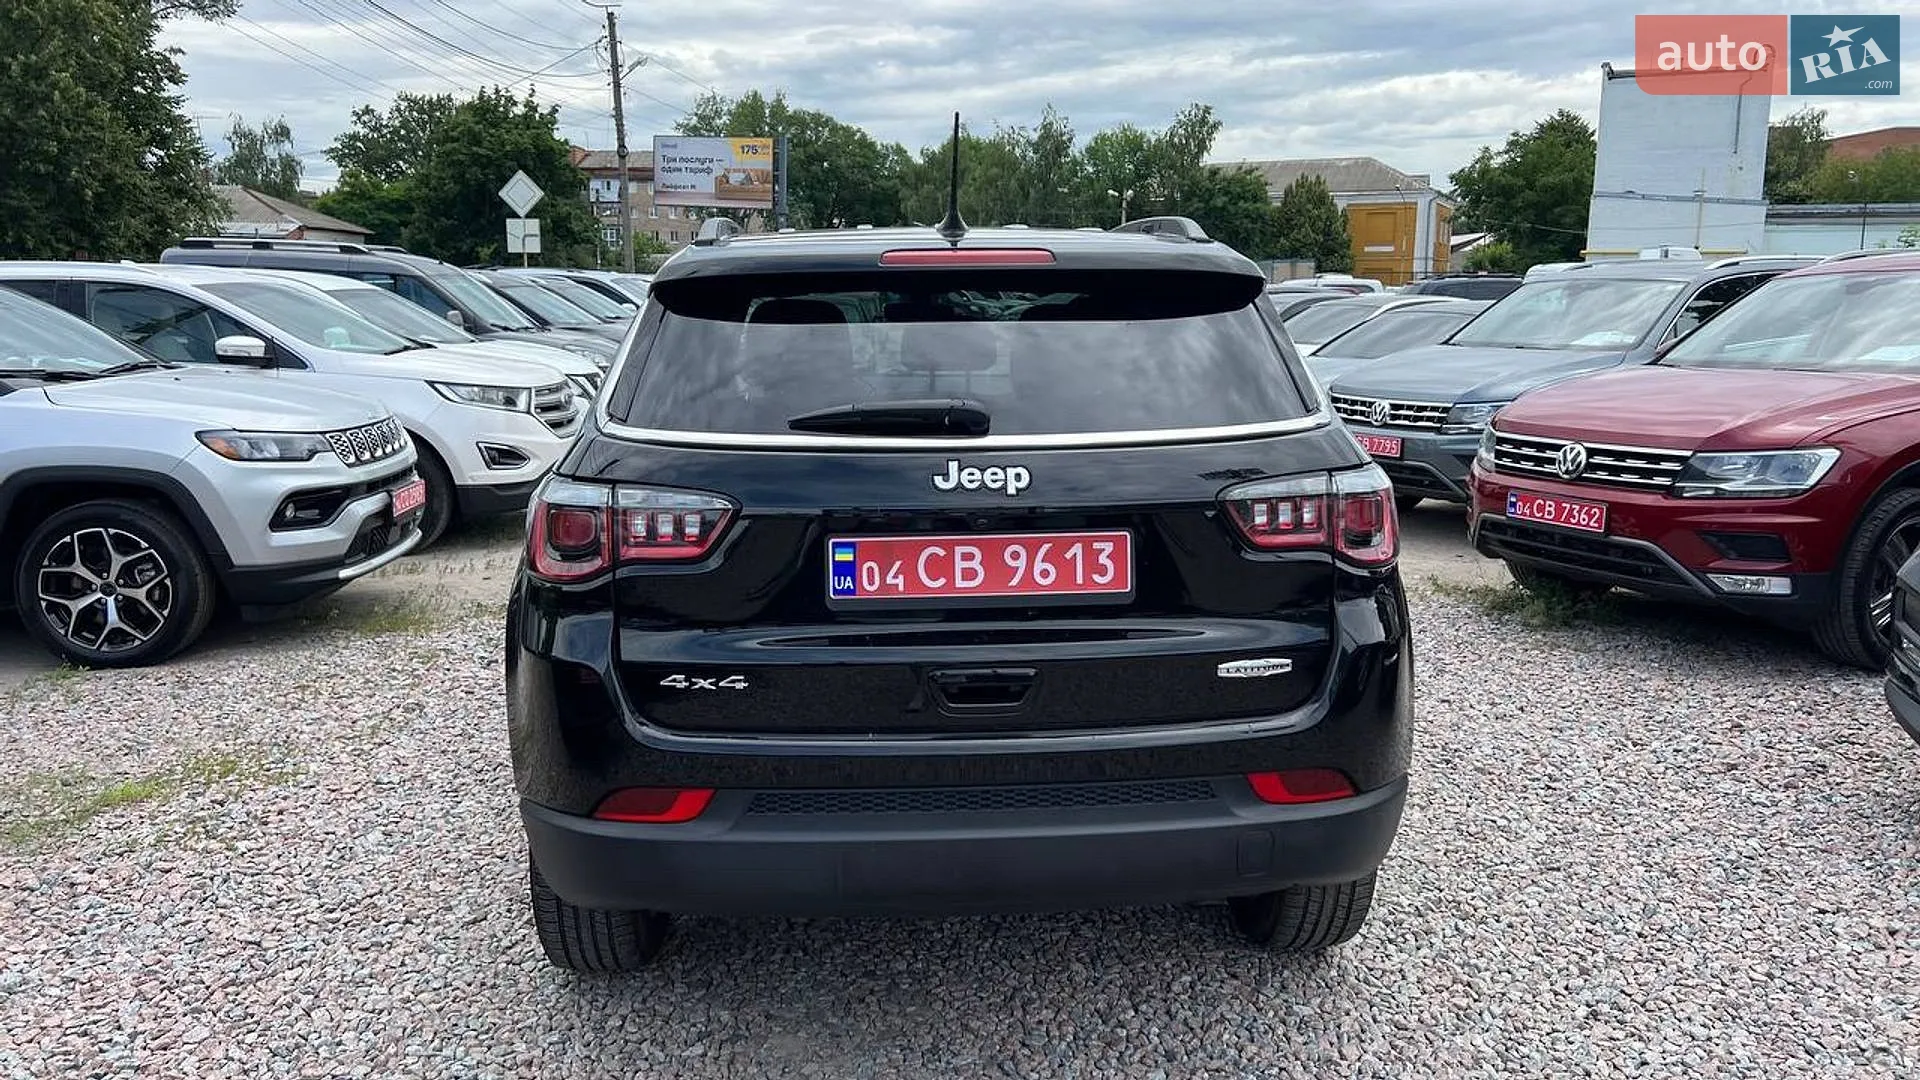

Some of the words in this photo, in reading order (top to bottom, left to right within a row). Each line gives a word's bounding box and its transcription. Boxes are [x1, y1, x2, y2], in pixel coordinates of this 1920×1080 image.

[661, 154, 677, 165] Три
[679, 156, 714, 165] послуги
[685, 166, 713, 175] тариф
[1372, 438, 1398, 454] 7795
[933, 460, 1031, 495] Jeep
[1516, 502, 1530, 516] 04
[1533, 499, 1555, 519] CB
[1560, 503, 1600, 527] 7362
[862, 560, 904, 592] 04
[917, 545, 986, 588] CB
[1003, 542, 1115, 587] 9613
[834, 575, 854, 590] UA
